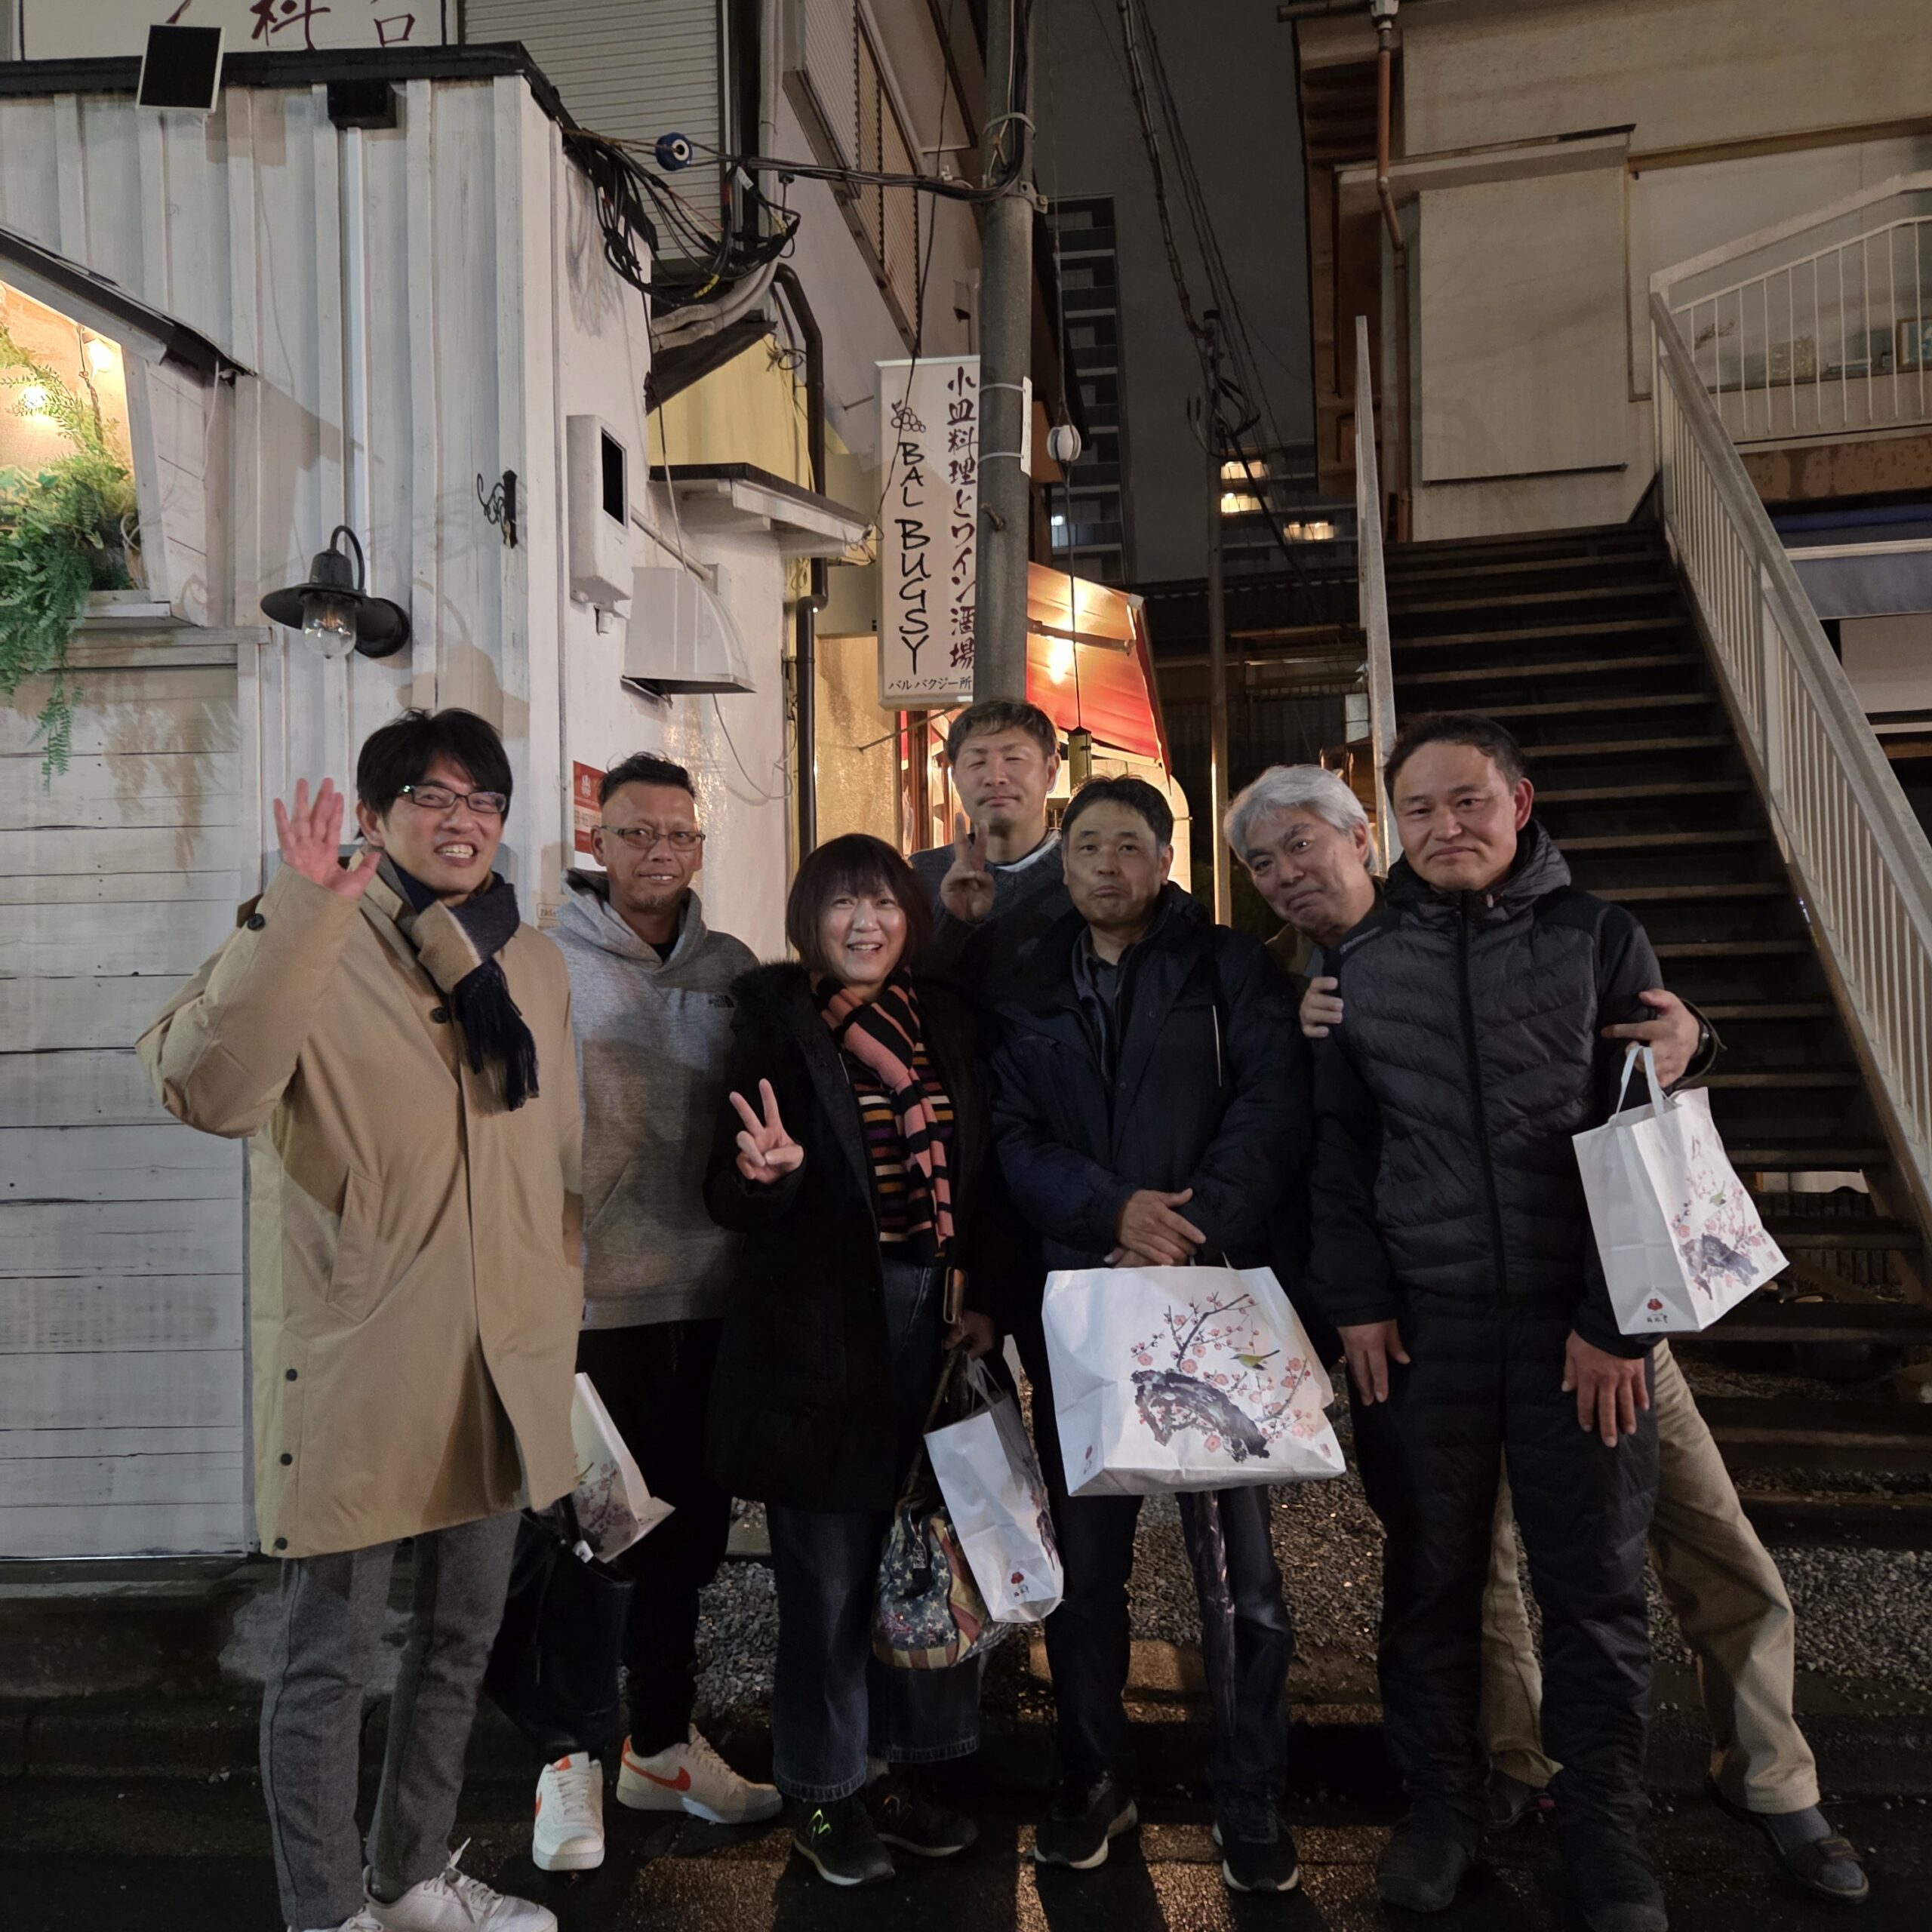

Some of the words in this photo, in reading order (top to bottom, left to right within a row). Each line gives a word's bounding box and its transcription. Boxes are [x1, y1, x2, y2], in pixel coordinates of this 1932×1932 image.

[898, 441, 924, 507] BAL
[946, 365, 978, 671] 小皿料理とワイン酒場
[894, 518, 931, 675] BUGSY
